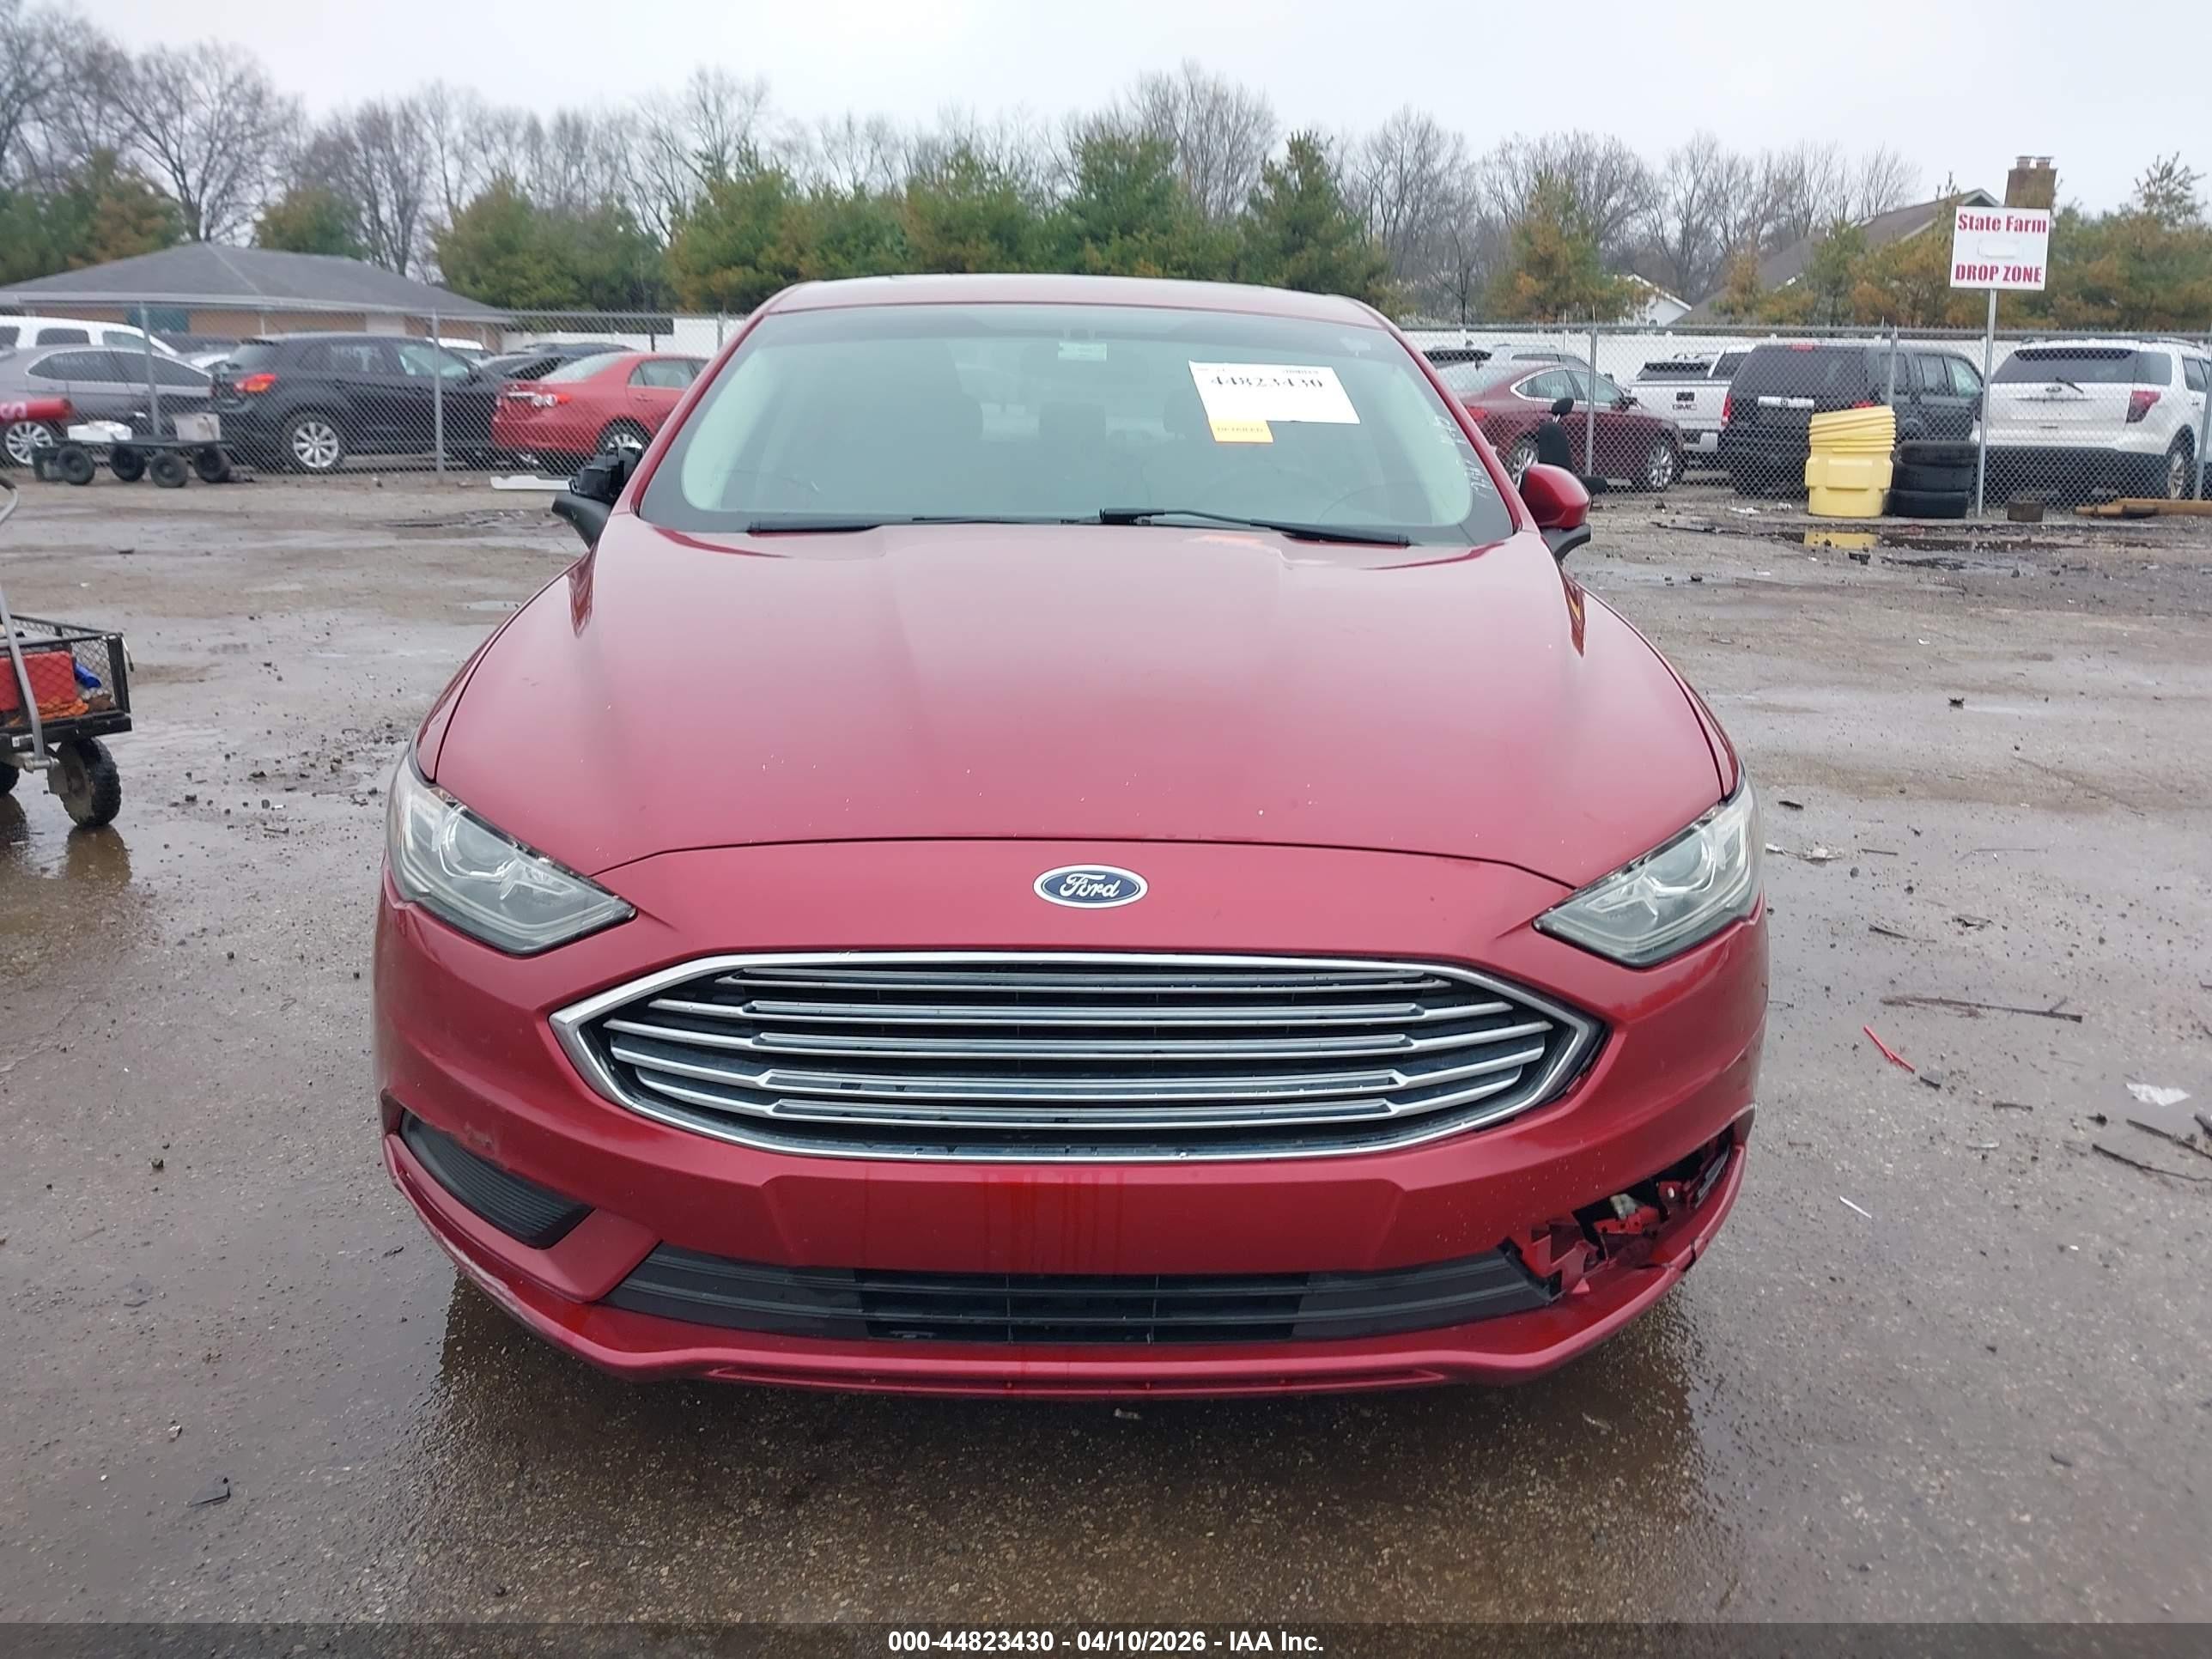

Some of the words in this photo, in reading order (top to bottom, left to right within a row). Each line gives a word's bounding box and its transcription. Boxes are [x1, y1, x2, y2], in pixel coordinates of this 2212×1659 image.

[1958, 212, 2002, 232] State
[2005, 215, 2047, 234] Farm
[1954, 264, 1999, 282] DROP
[2002, 265, 2042, 283] ZONE
[1059, 872, 1121, 898] Ford
